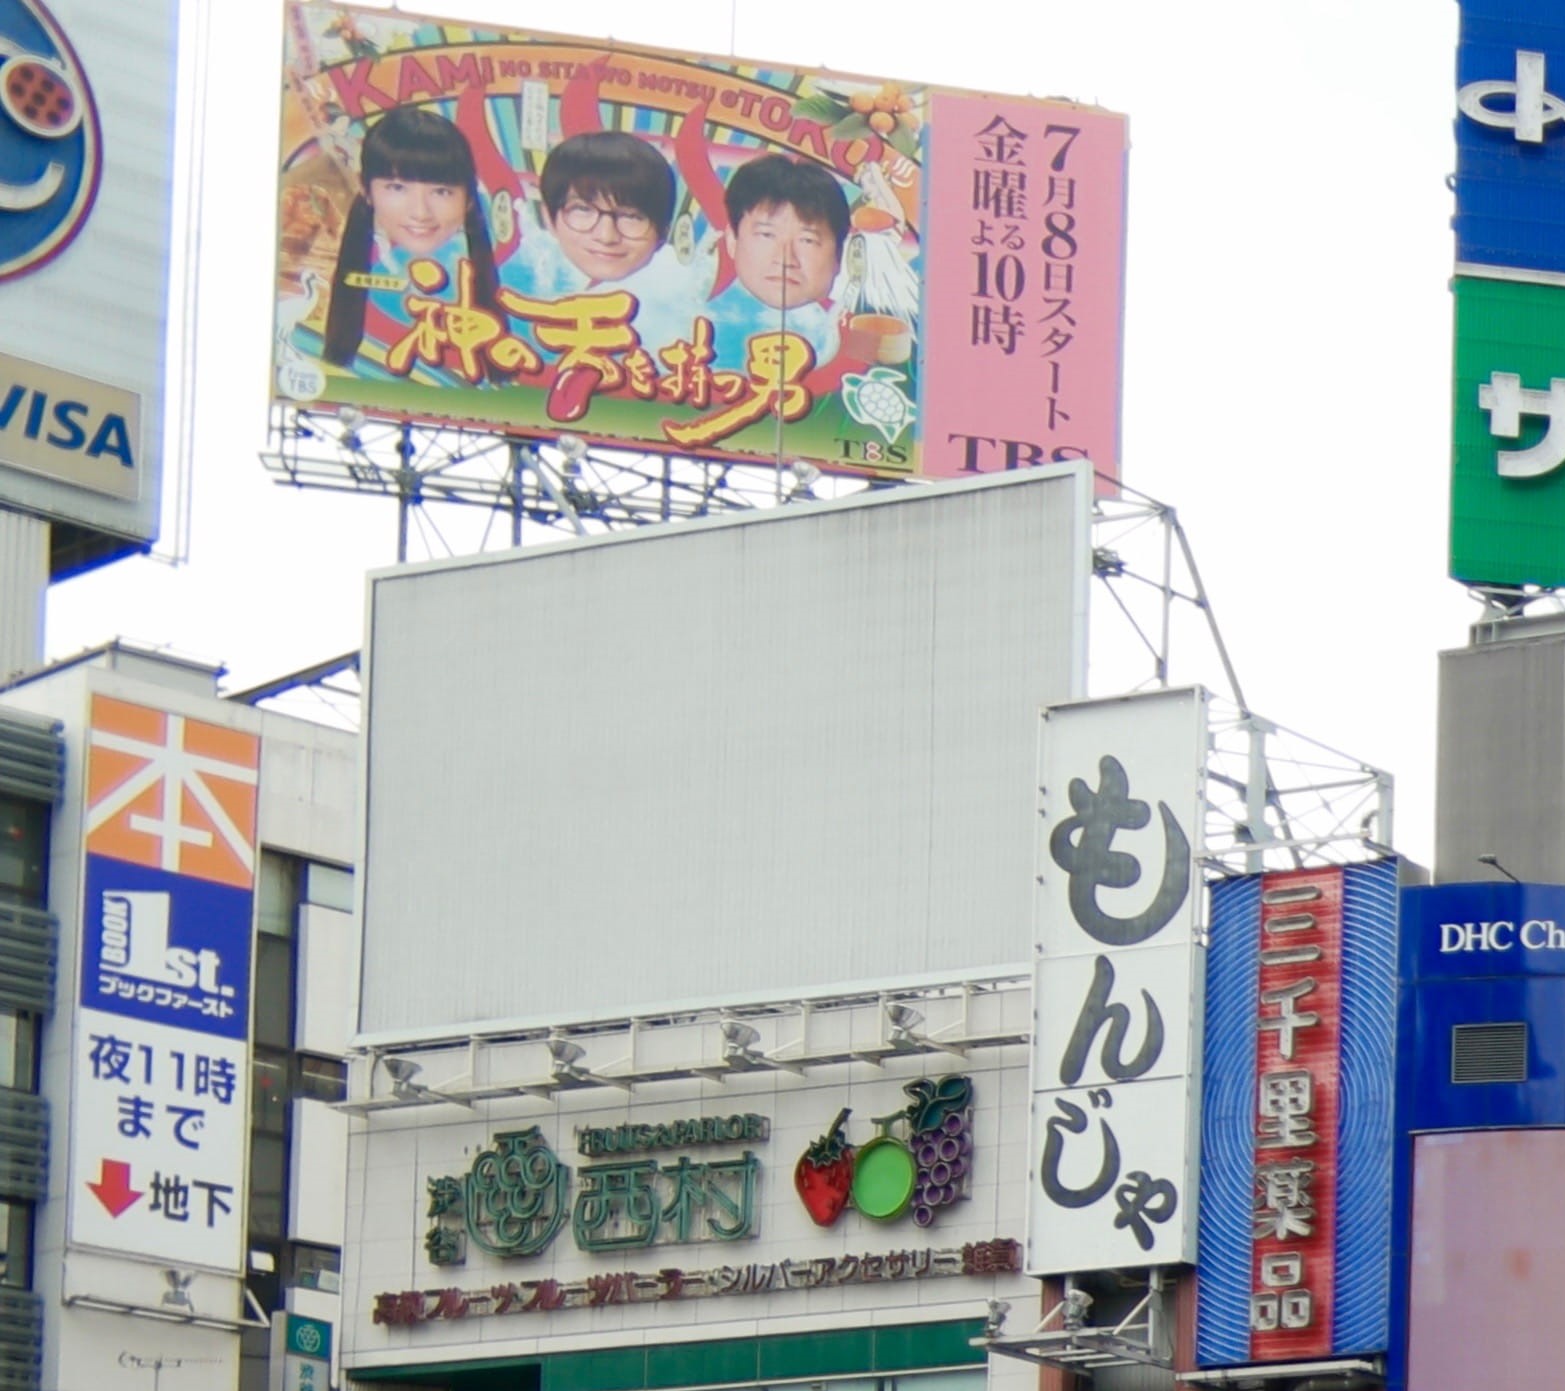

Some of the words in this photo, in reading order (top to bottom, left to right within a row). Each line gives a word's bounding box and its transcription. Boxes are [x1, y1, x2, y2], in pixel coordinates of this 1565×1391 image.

[328, 53, 495, 119] KAMI
[970, 115, 1029, 355] 金曜よる10時
[1041, 123, 1081, 431] 7月8日スタート
[87, 713, 257, 873] 本
[1441, 920, 1514, 953] DHC
[99, 975, 234, 1019] ブックファースト
[1041, 755, 1190, 1250] もんじゃ
[90, 1033, 236, 1106] 夜11時
[117, 1095, 206, 1151] まで
[1251, 883, 1322, 1331] 三千里薬品
[150, 1169, 234, 1228] 地下
